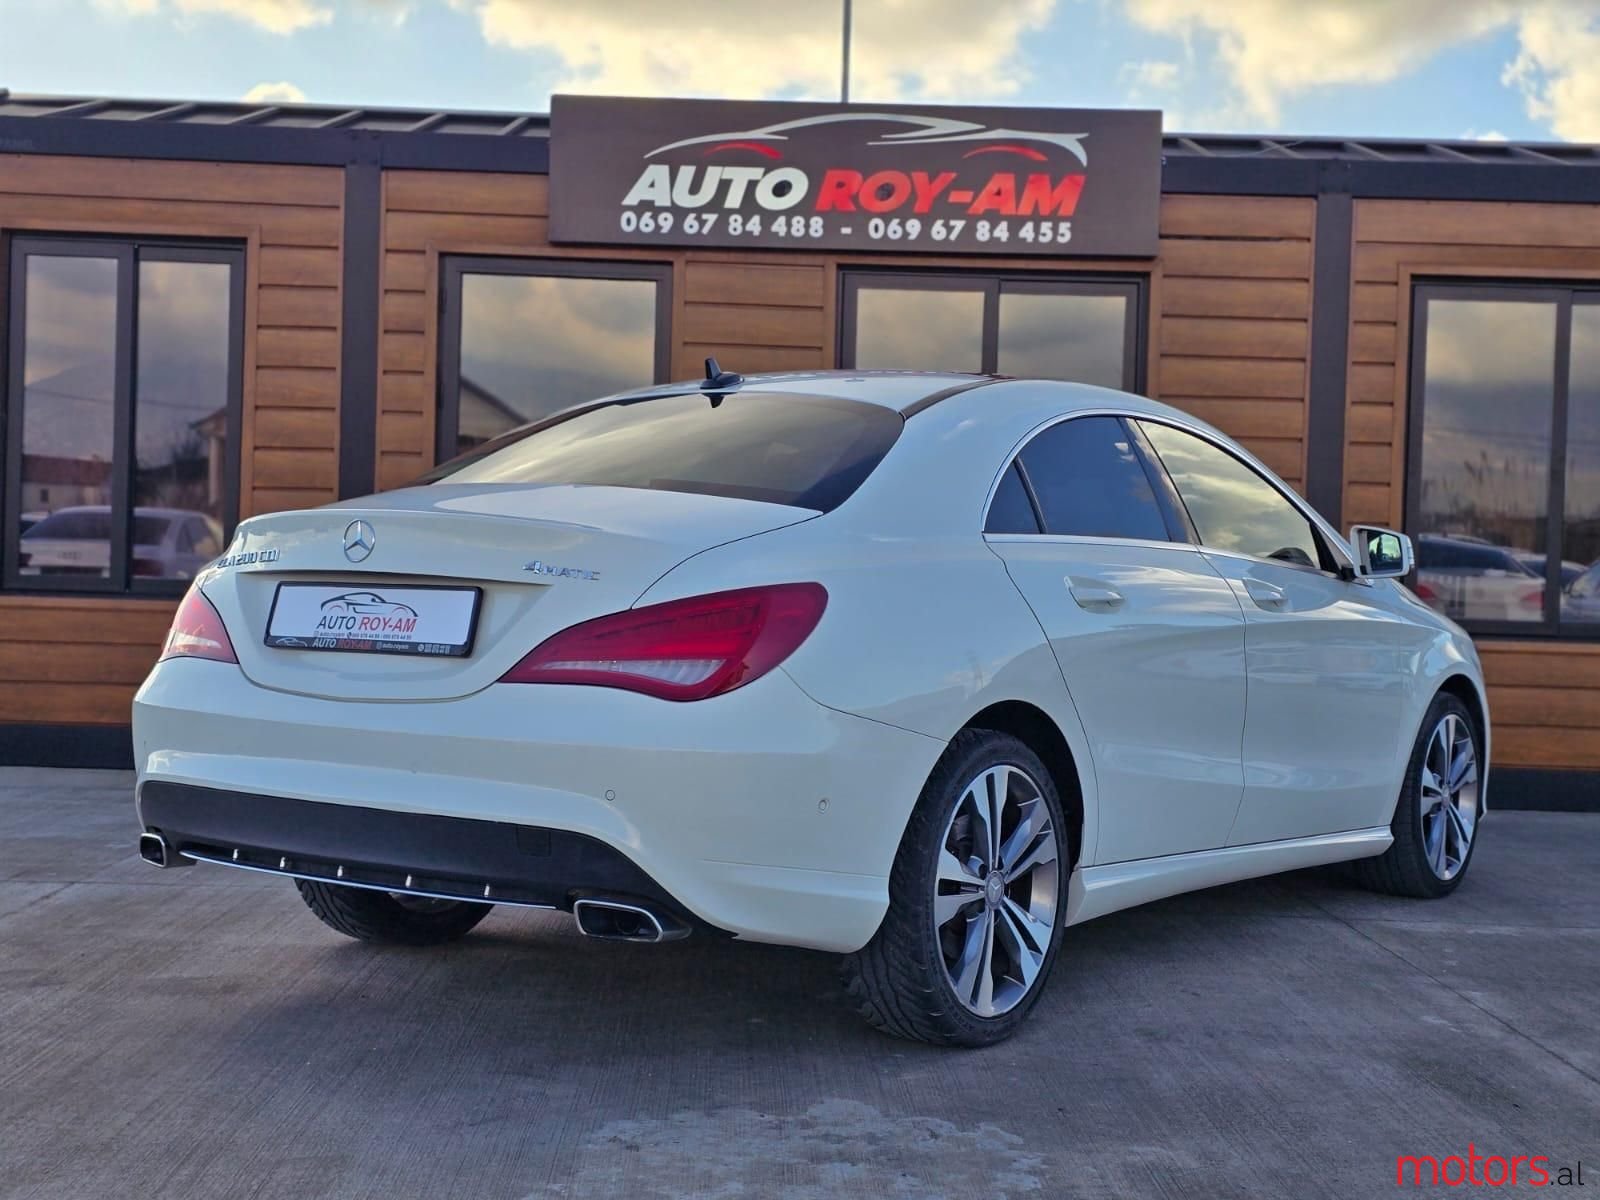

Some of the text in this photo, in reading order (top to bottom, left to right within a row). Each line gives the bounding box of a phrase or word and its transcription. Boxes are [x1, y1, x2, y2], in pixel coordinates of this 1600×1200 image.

[621, 165, 1087, 216] AUTO ROY-AM
[620, 211, 674, 234] 069
[683, 213, 719, 235] 67
[728, 214, 762, 237] 84
[771, 215, 824, 238] 488
[868, 217, 922, 241] 069
[931, 219, 967, 242] 67
[976, 220, 1010, 243] 84
[1018, 221, 1073, 244] 455
[316, 615, 418, 633] AUTO ROY-AM
[312, 637, 337, 649] AUTO
